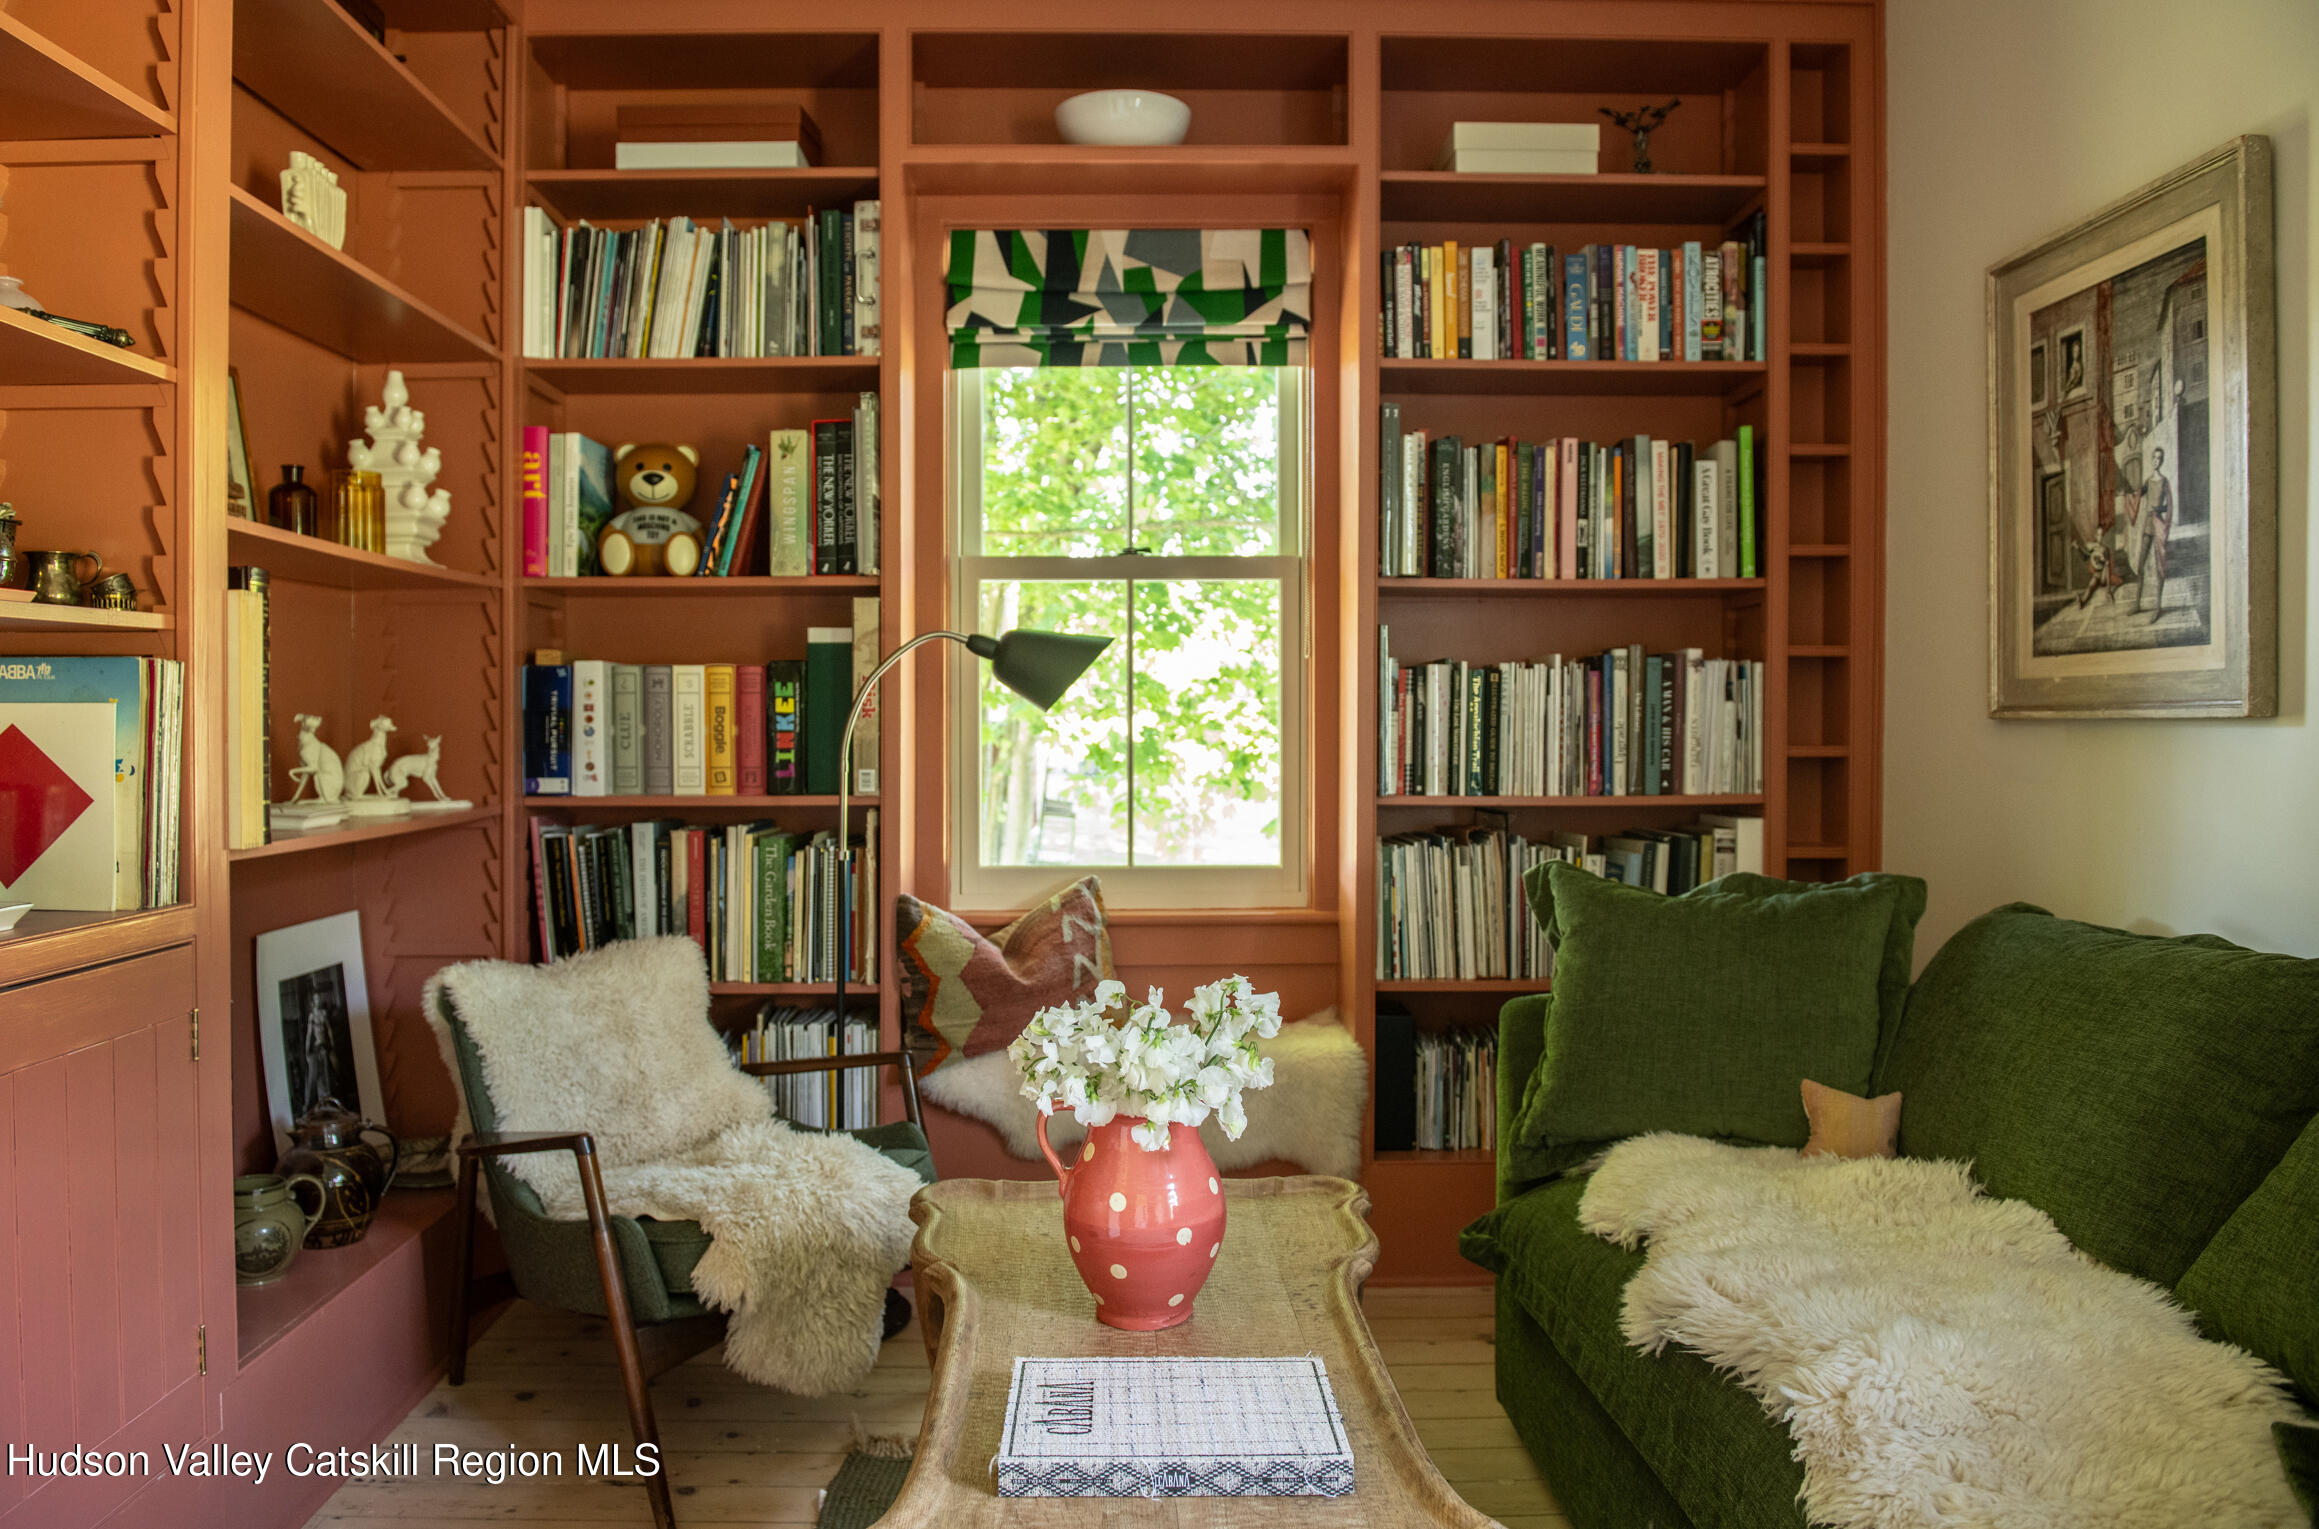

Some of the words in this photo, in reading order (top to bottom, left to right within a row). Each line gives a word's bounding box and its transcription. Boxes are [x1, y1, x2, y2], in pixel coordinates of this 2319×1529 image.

[1704, 256, 1720, 317] ATROCITIES
[524, 451, 547, 500] art
[823, 454, 835, 474] THE
[1702, 466, 1712, 474] A
[823, 476, 835, 500] NEW
[1702, 474, 1712, 504] Great
[783, 465, 796, 545] WINGSPAN
[1699, 506, 1712, 524] Gay
[823, 504, 836, 546] YORKER
[1702, 528, 1713, 554] Book
[0, 664, 36, 680] ABBA
[1472, 676, 1480, 695] The
[550, 690, 558, 727] TRIVIAL
[1663, 690, 1672, 712] MAN
[620, 712, 631, 750] CLUE
[653, 696, 664, 761] MONOPOLY
[684, 704, 696, 759] SCRABBLE
[714, 706, 726, 754] Boggle
[775, 680, 795, 778] LINKEE
[1470, 696, 1480, 750] Appalachian
[1662, 727, 1672, 744] HIS
[550, 729, 558, 771] PURSUIT
[1472, 751, 1480, 772] Trail
[1662, 748, 1672, 770] CAR
[765, 844, 778, 868] The
[764, 871, 776, 917] Garden
[764, 919, 776, 951] Book
[1032, 1381, 1094, 1435] CABANA
[1158, 1472, 1190, 1488] CABANA
